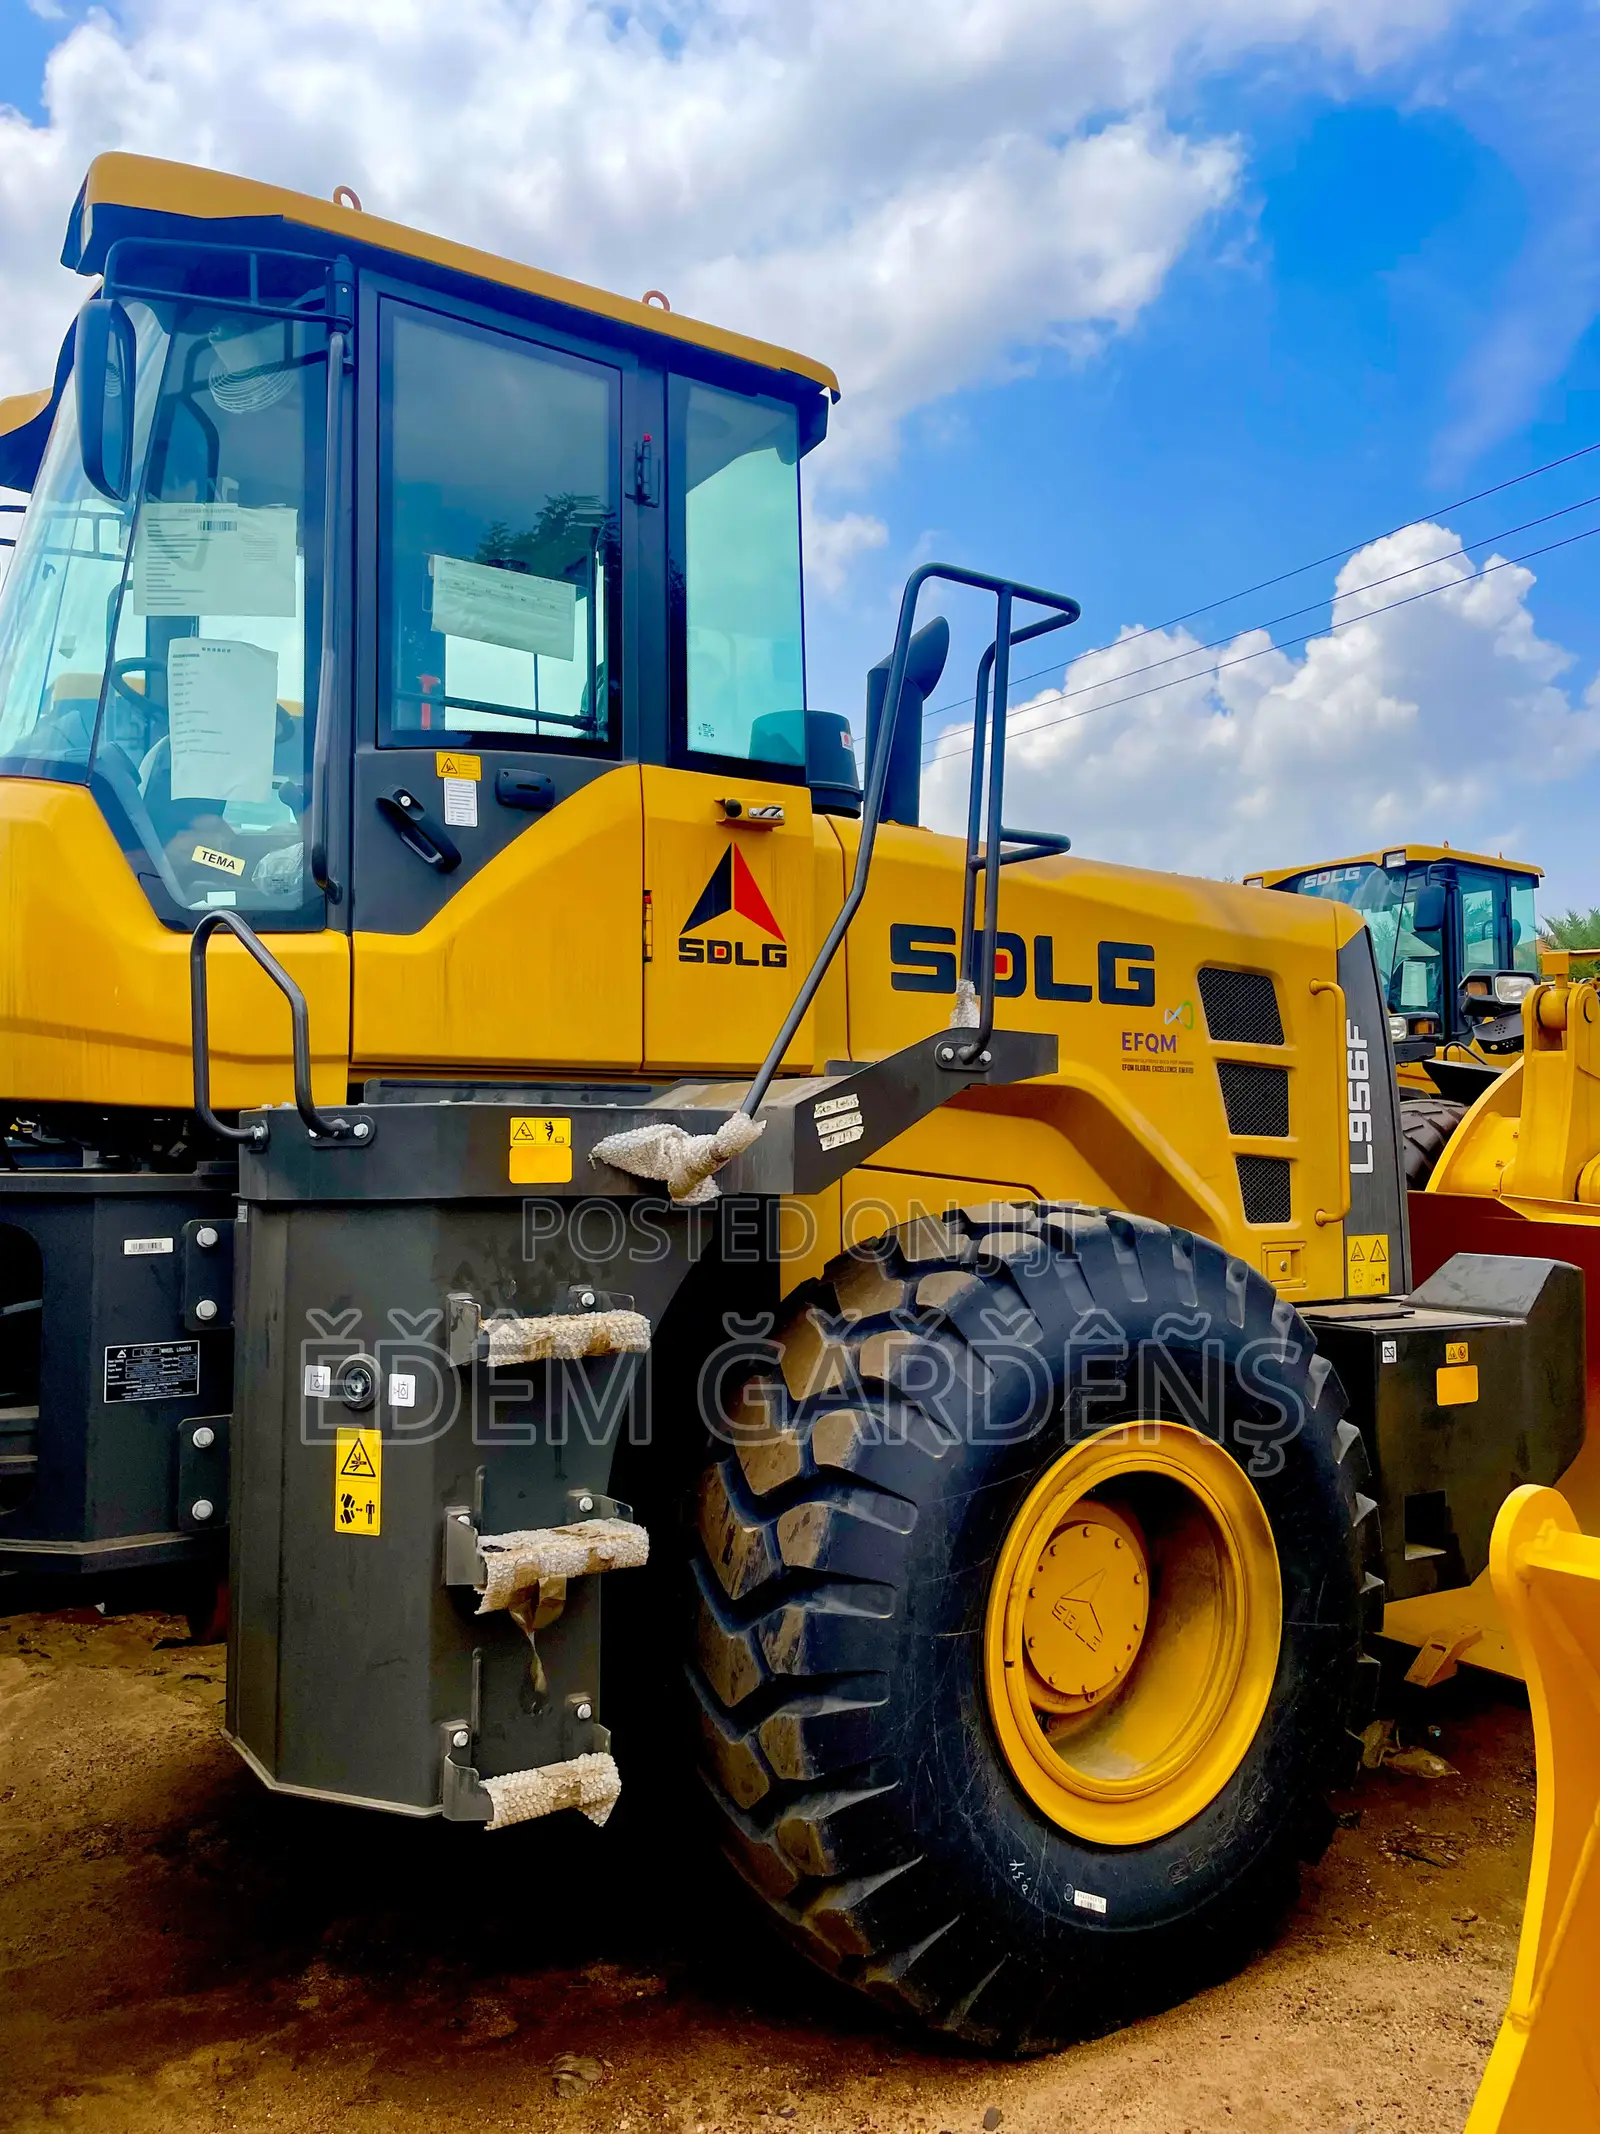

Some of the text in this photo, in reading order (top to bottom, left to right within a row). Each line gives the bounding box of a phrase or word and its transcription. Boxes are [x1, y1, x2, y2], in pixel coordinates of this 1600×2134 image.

[201, 850, 236, 870] TEMA
[1303, 866, 1361, 889] SDLG
[678, 937, 788, 968] SDLG
[890, 923, 1155, 1007] SDLG
[1121, 1031, 1177, 1054] EFQM
[1346, 1018, 1374, 1174] L956F
